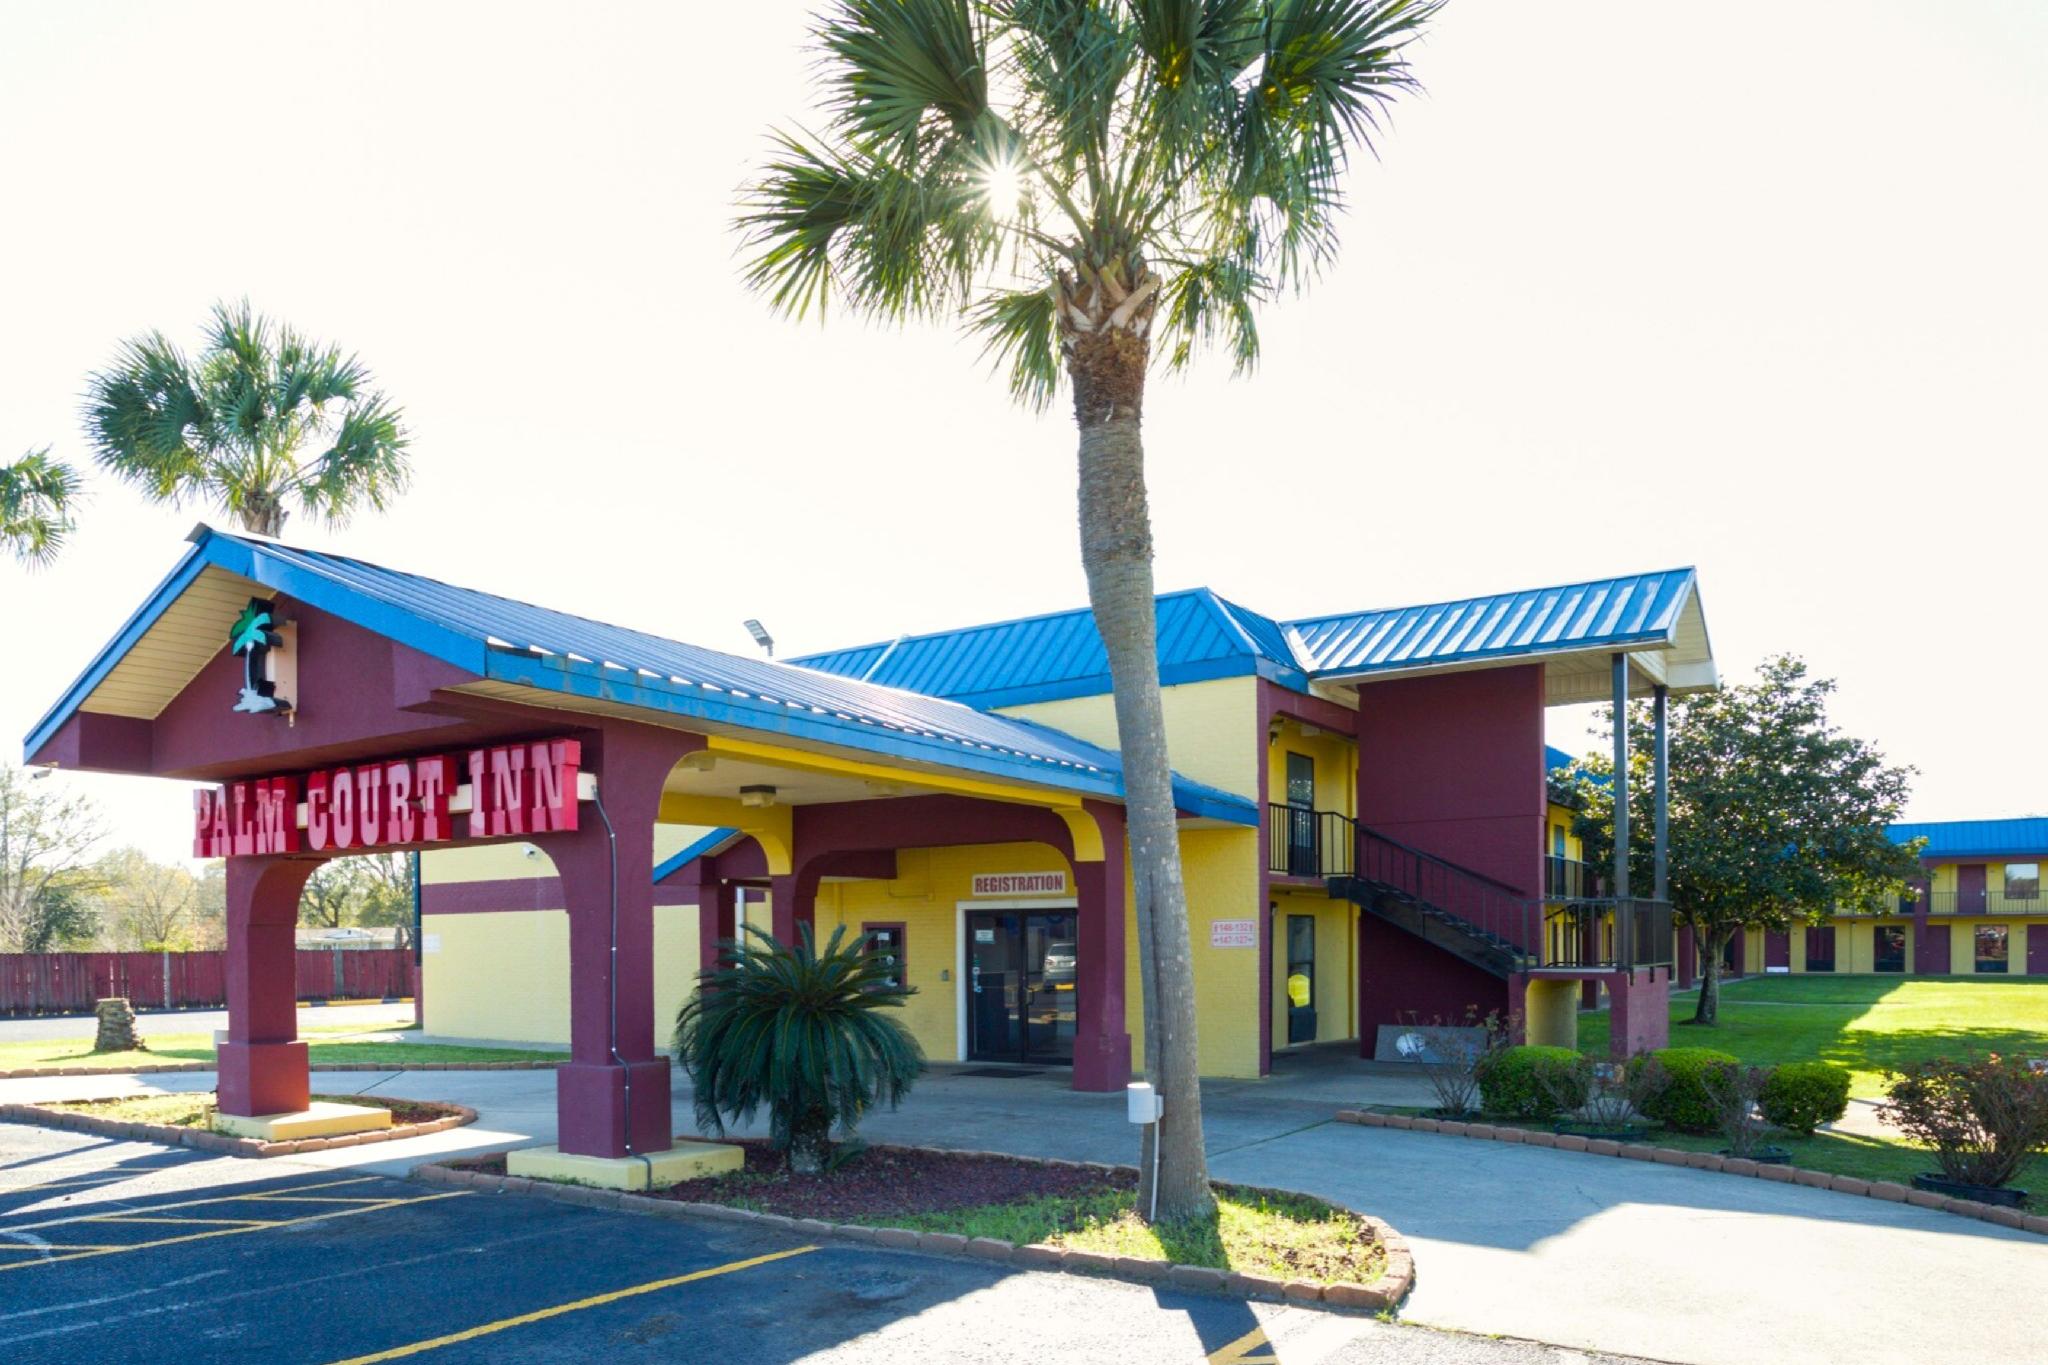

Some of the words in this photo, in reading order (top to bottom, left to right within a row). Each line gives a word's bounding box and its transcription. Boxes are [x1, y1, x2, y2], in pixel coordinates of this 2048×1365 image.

[193, 778, 288, 857] PALM
[308, 756, 445, 850] COURT
[469, 740, 567, 838] INN
[974, 875, 1063, 893] REGISTRATION
